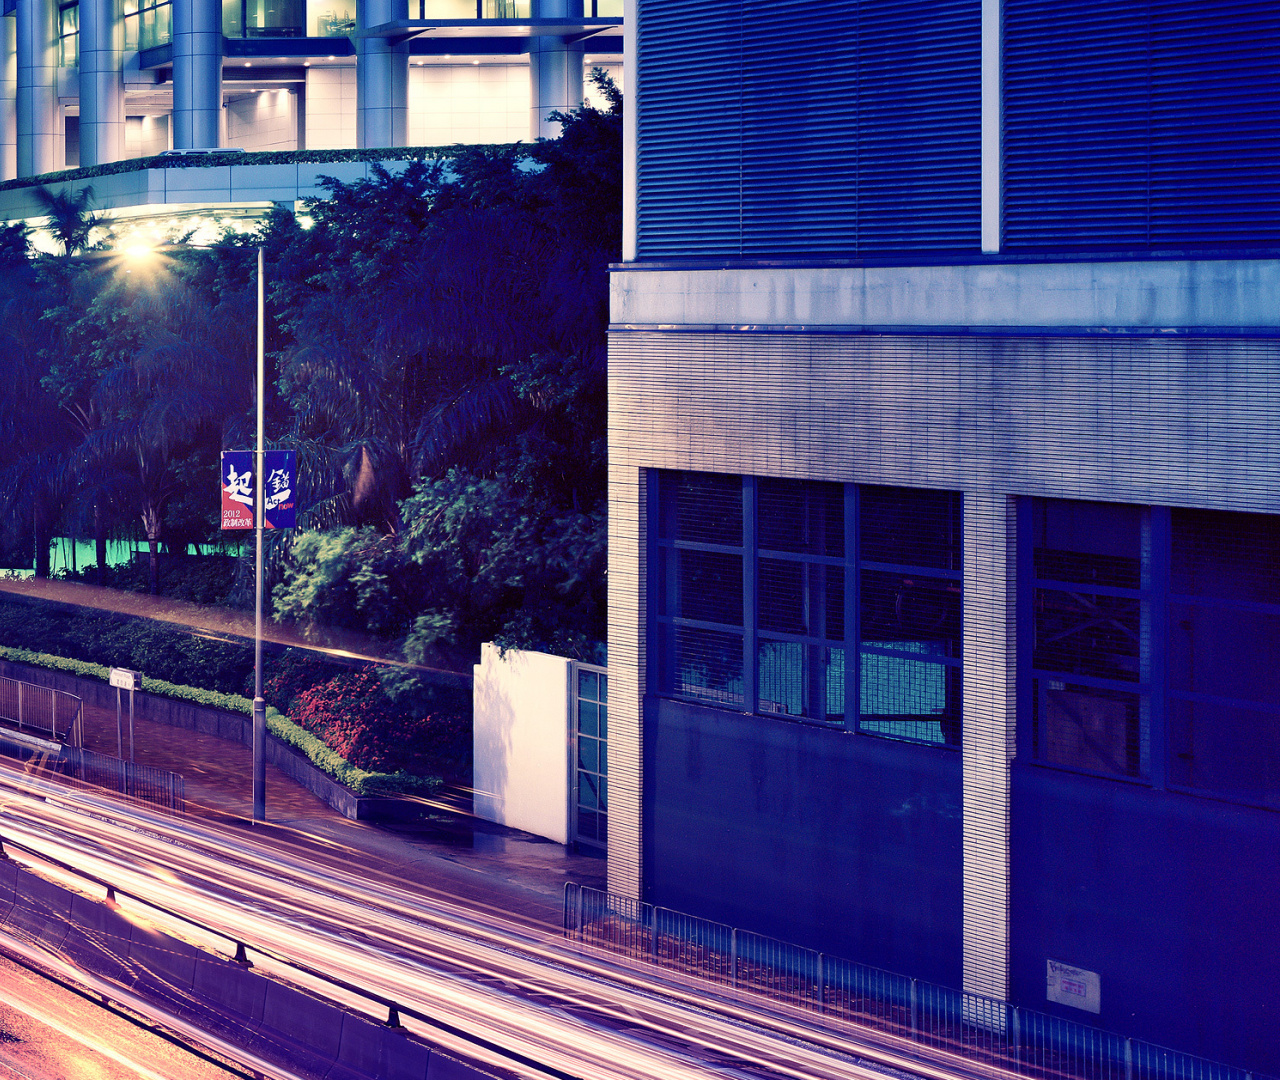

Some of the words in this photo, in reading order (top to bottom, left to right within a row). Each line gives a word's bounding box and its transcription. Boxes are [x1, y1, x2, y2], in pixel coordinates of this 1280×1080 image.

[223, 464, 253, 506] 起
[278, 502, 294, 510] now
[223, 510, 240, 518] 2012
[223, 518, 252, 528] 政制改革
